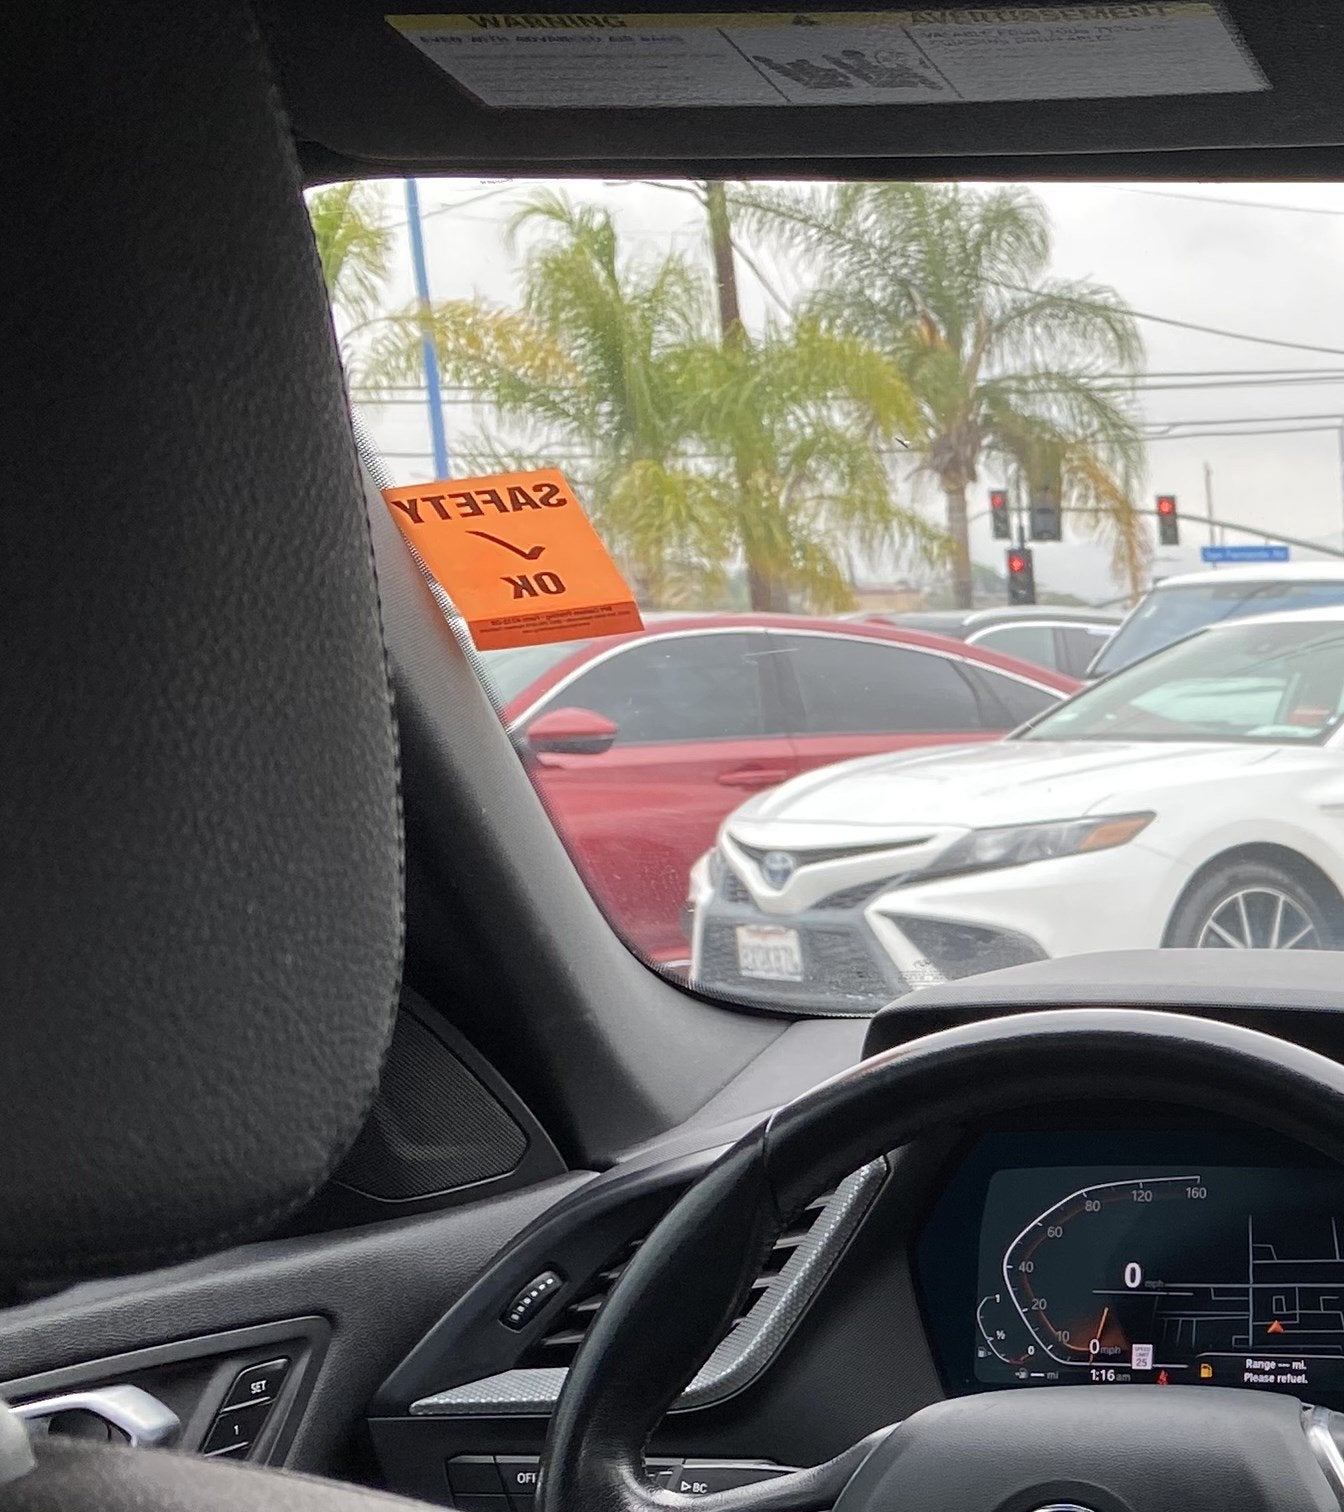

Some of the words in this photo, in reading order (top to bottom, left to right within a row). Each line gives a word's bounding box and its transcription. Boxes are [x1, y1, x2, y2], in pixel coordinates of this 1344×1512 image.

[466, 14, 628, 29] WARNING
[1131, 1190, 1153, 1202] 120
[1185, 1187, 1208, 1200] 160
[1084, 1200, 1101, 1213] 80
[1047, 1226, 1064, 1239] 60
[1018, 1261, 1035, 1273] 40
[1124, 1262, 1142, 1289] 0
[1031, 1299, 1048, 1311] 20
[1056, 1330, 1070, 1343] 10
[1136, 1358, 1148, 1368] 25
[1245, 1358, 1277, 1371] Range
[1243, 1372, 1276, 1384] Please
[1276, 1372, 1308, 1385] refuel.
[250, 1379, 267, 1395] SET
[233, 1424, 240, 1436] 1
[692, 1481, 708, 1494] BC
